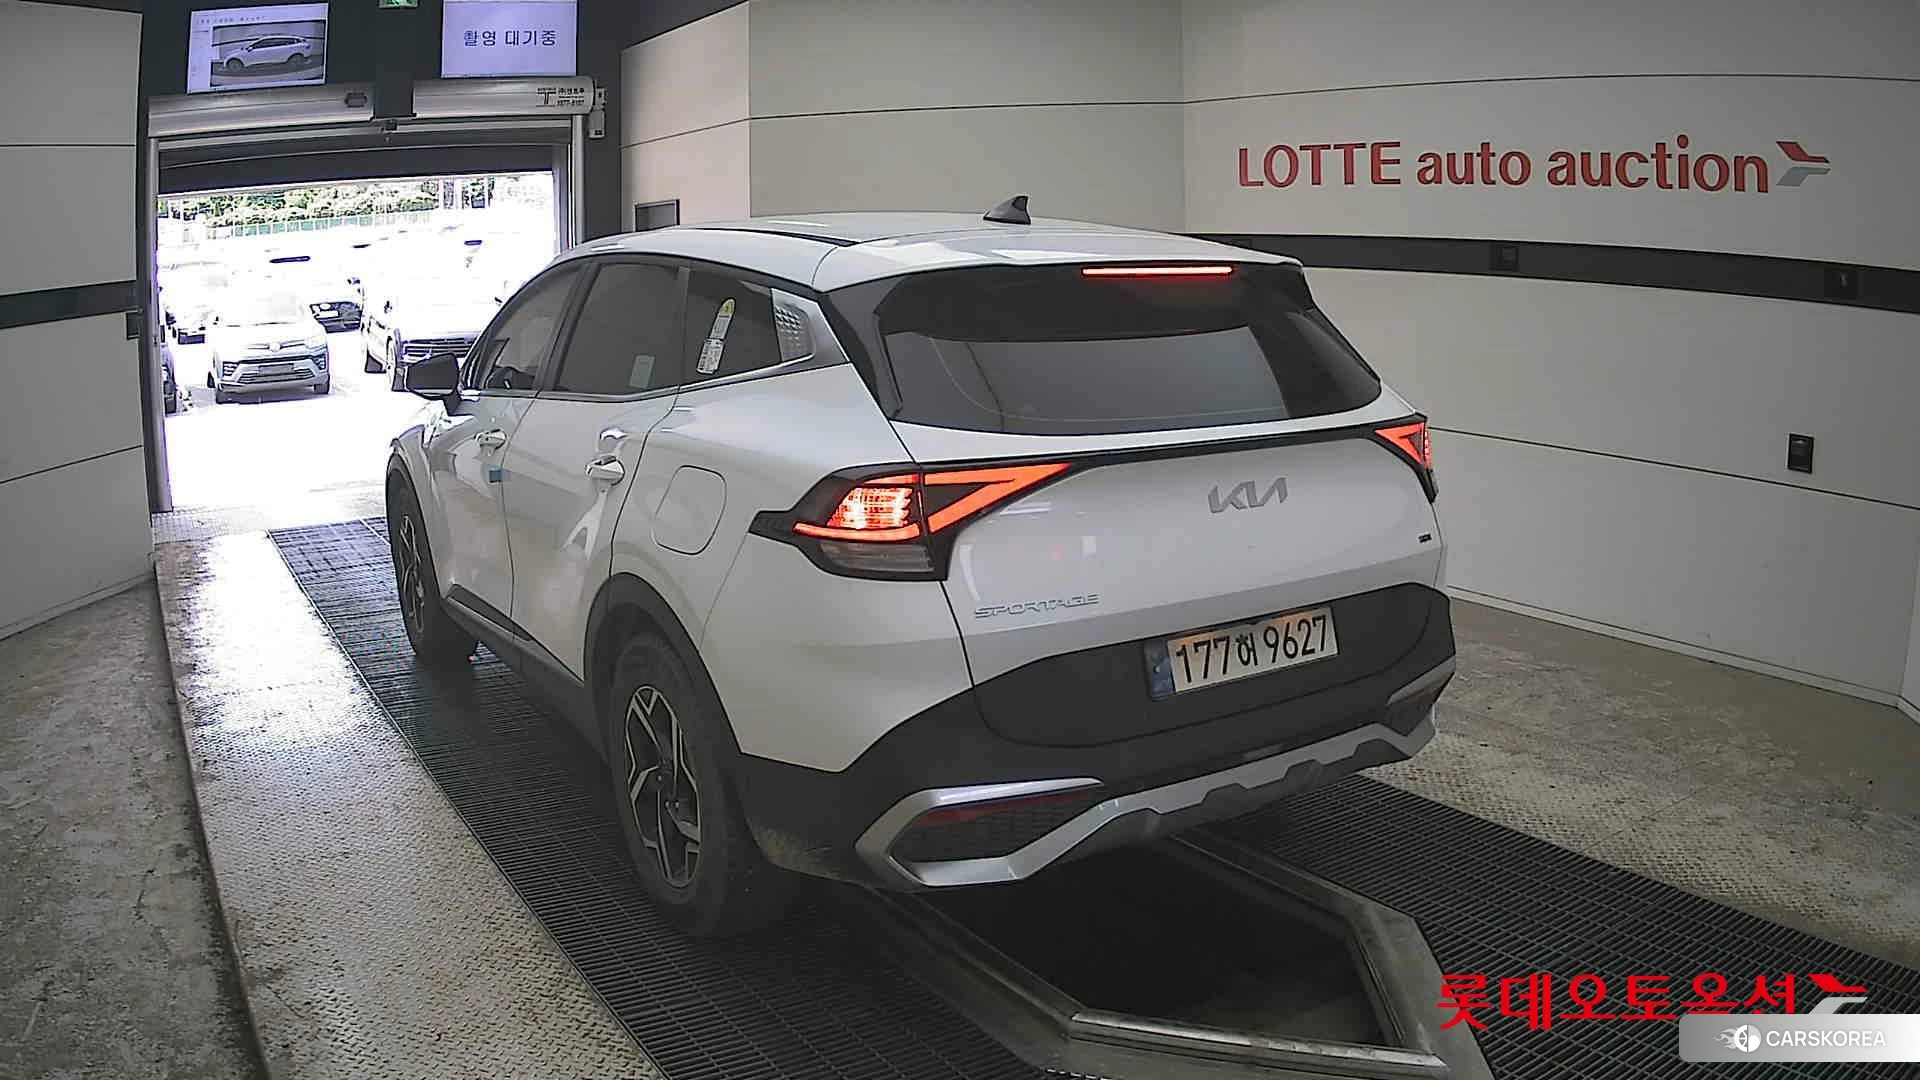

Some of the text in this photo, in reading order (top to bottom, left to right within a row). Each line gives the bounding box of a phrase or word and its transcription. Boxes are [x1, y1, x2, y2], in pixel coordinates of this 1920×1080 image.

[504, 30, 556, 46] 대기중
[1238, 134, 1769, 193] LOTTE auto auction
[1207, 477, 1288, 514] KIA
[974, 592, 1099, 619] SPORTAGE
[1263, 614, 1327, 663] 9627
